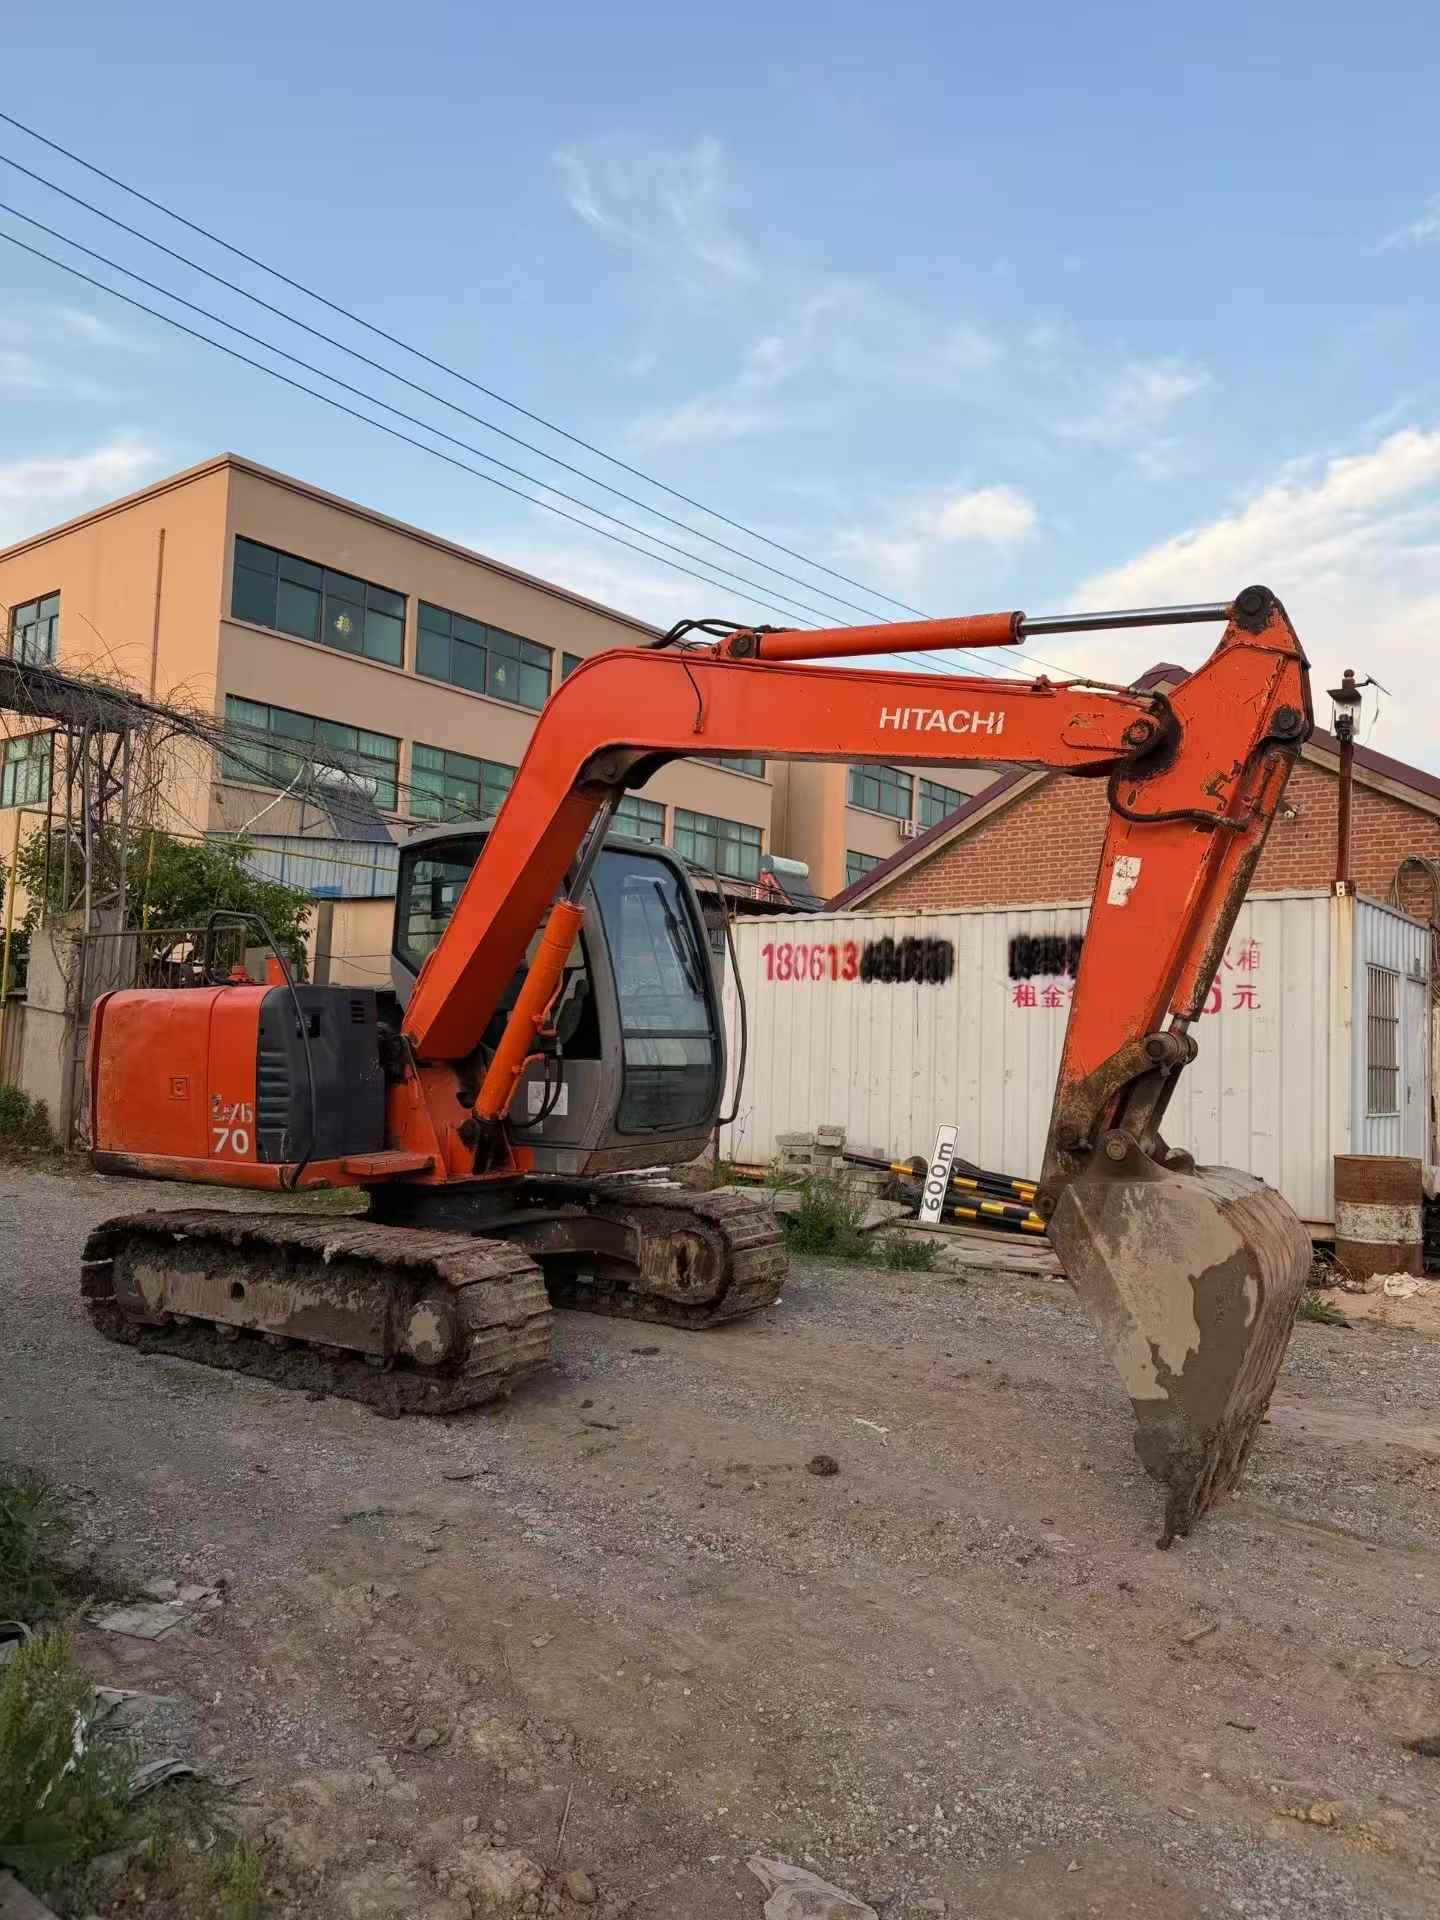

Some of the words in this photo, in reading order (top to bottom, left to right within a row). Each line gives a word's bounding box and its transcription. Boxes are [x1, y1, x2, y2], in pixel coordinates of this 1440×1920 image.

[879, 706, 1006, 736] HITACHI
[761, 940, 859, 982] 180613
[1012, 983, 1073, 1009] 租金
[211, 1126, 250, 1155] 70
[924, 1142, 954, 1212] 600m
